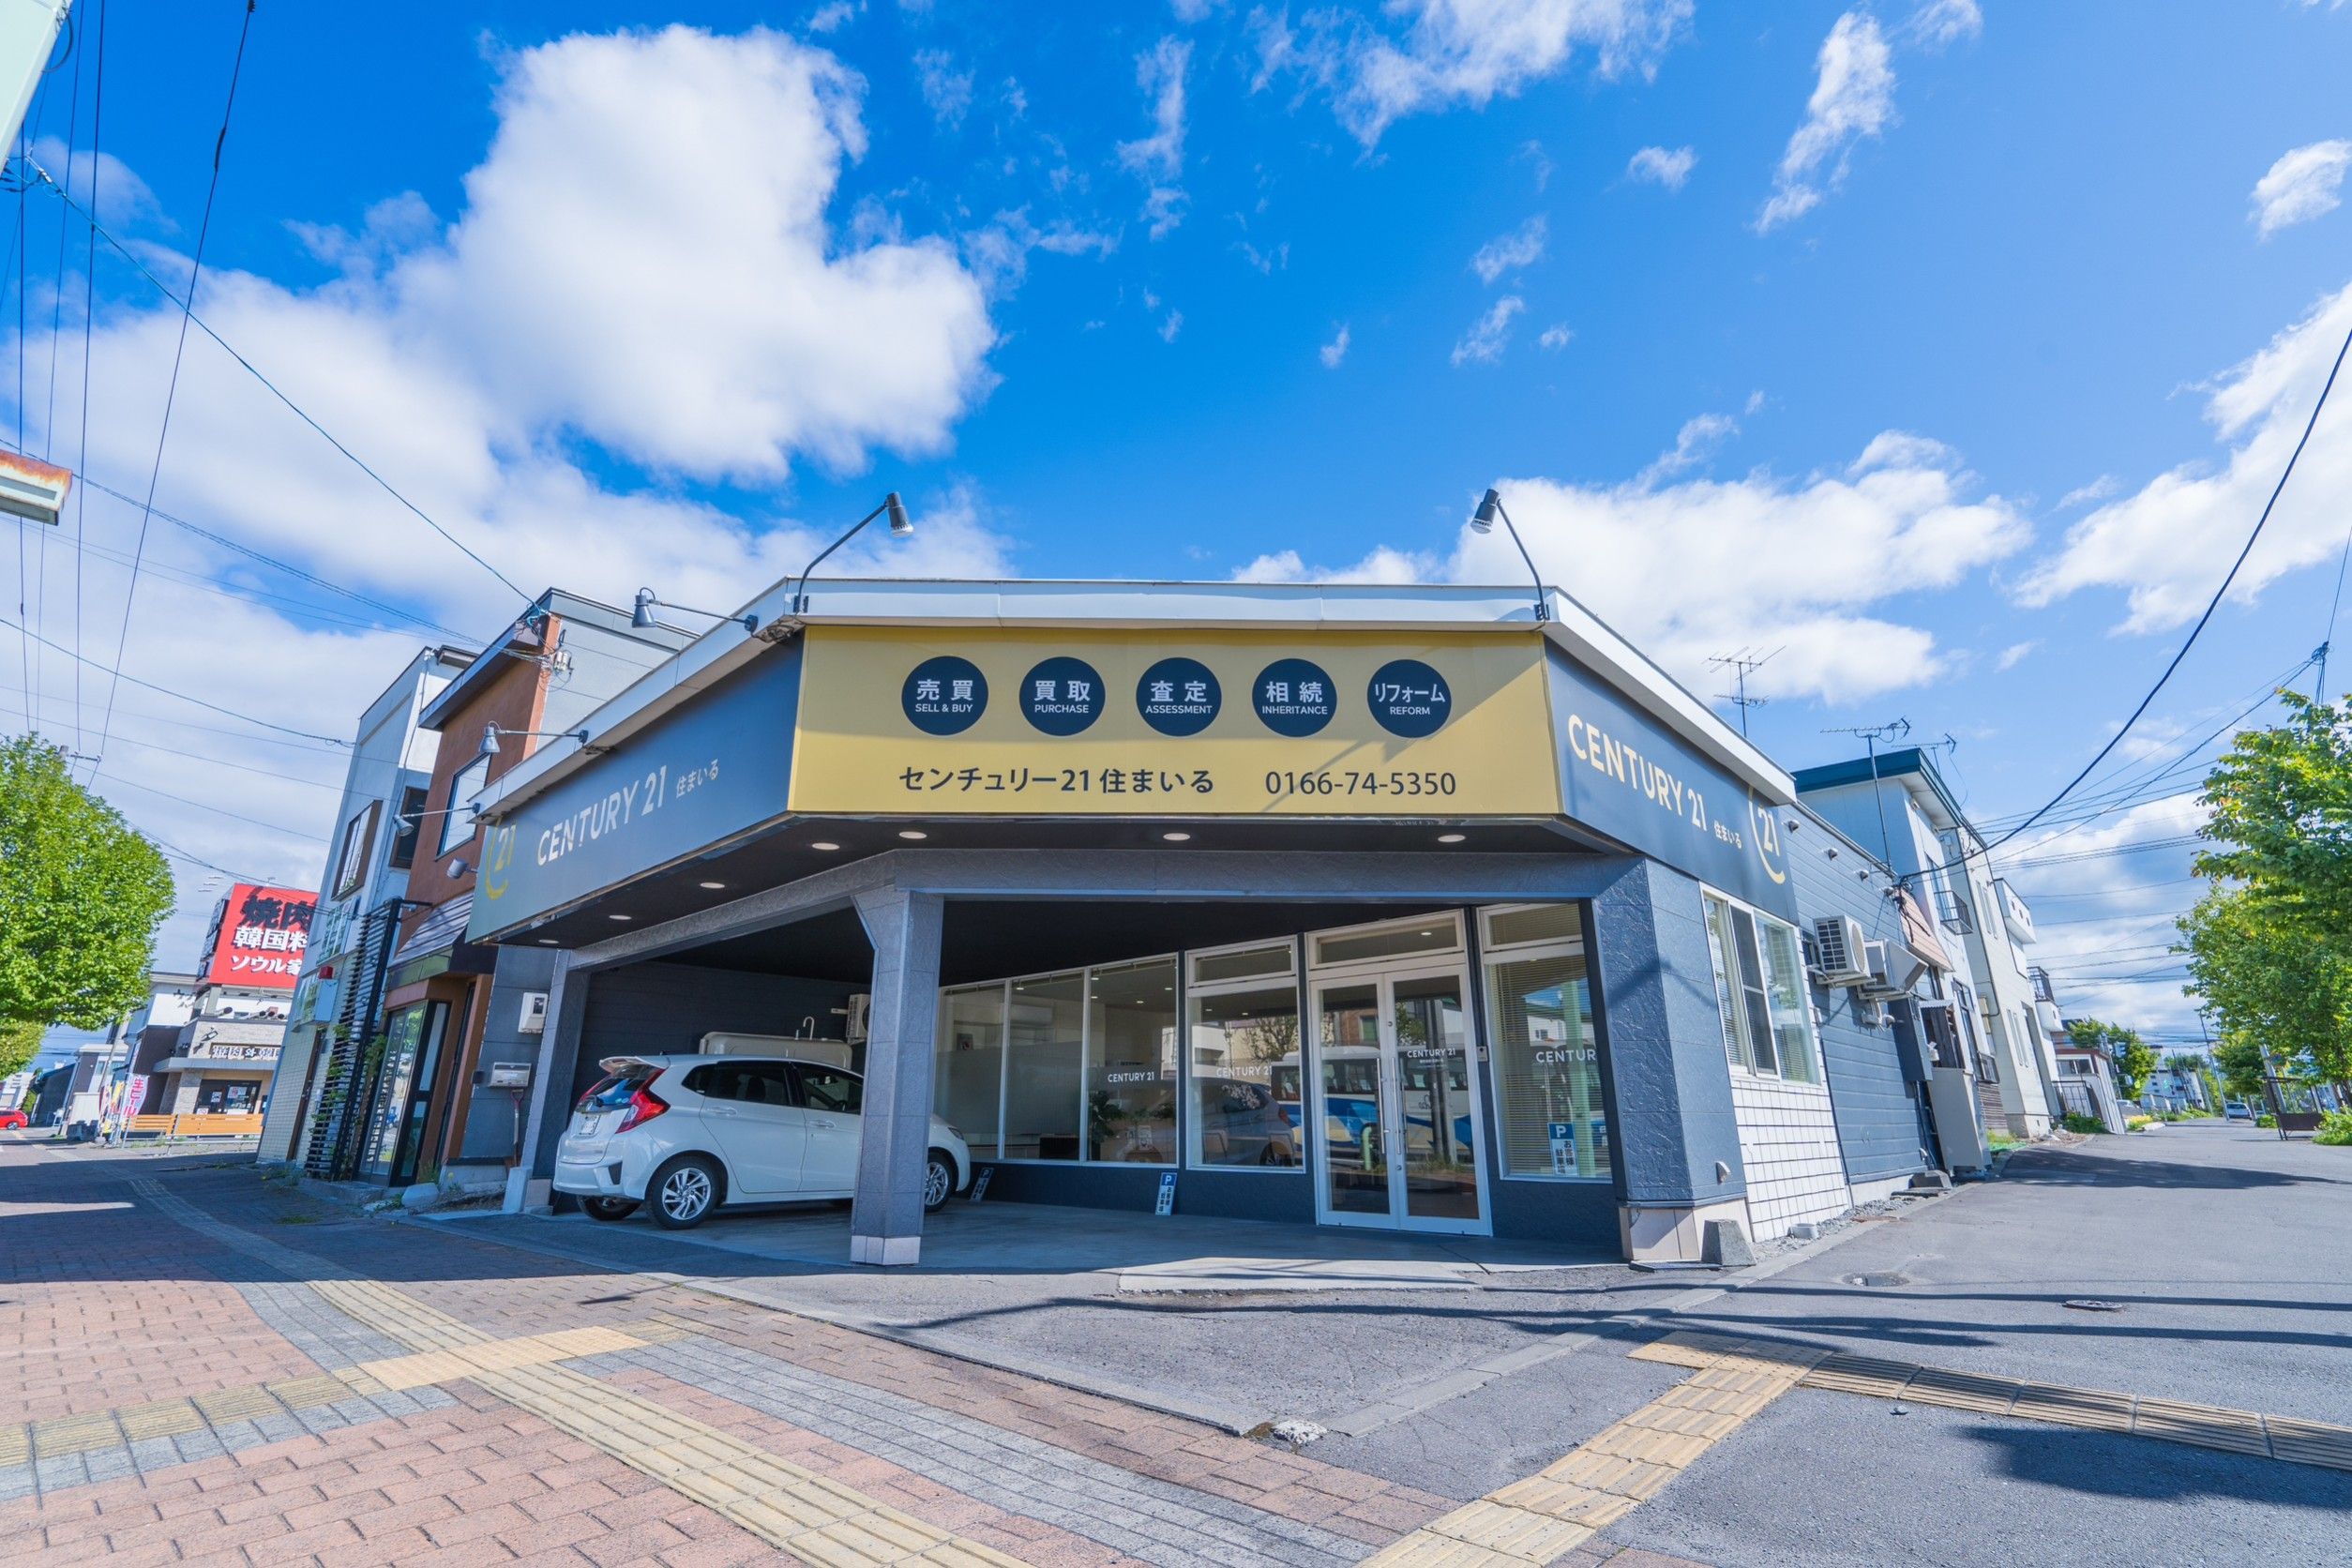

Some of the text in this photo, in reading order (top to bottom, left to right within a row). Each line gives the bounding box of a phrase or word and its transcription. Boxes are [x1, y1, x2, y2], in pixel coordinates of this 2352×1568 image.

[916, 679, 974, 701] 売買
[1033, 680, 1091, 702] 買取
[1150, 680, 1208, 703] 査定
[1265, 681, 1323, 704] 相続
[1373, 683, 1446, 703] リフォーム
[915, 703, 973, 714] SELL & BUY
[1034, 703, 1090, 714] PURCHASE
[1145, 704, 1213, 715] ASSESSMENT
[1261, 705, 1328, 716] INHERITANCE
[1389, 706, 1431, 716] REFORM
[1264, 771, 1457, 795] 0166-74-5350
[1567, 714, 1742, 850] CENTURY 21 住まいる
[537, 759, 719, 867] CENTURY 21 住まいる
[239, 895, 315, 931] 焼肉
[1407, 1048, 1456, 1059] CENTURY 21
[1108, 1071, 1155, 1083] CENTURY 21
[1216, 1065, 1273, 1078] CENTURY 21
[1555, 1124, 1567, 1138] P
[1164, 1174, 1172, 1185] P
